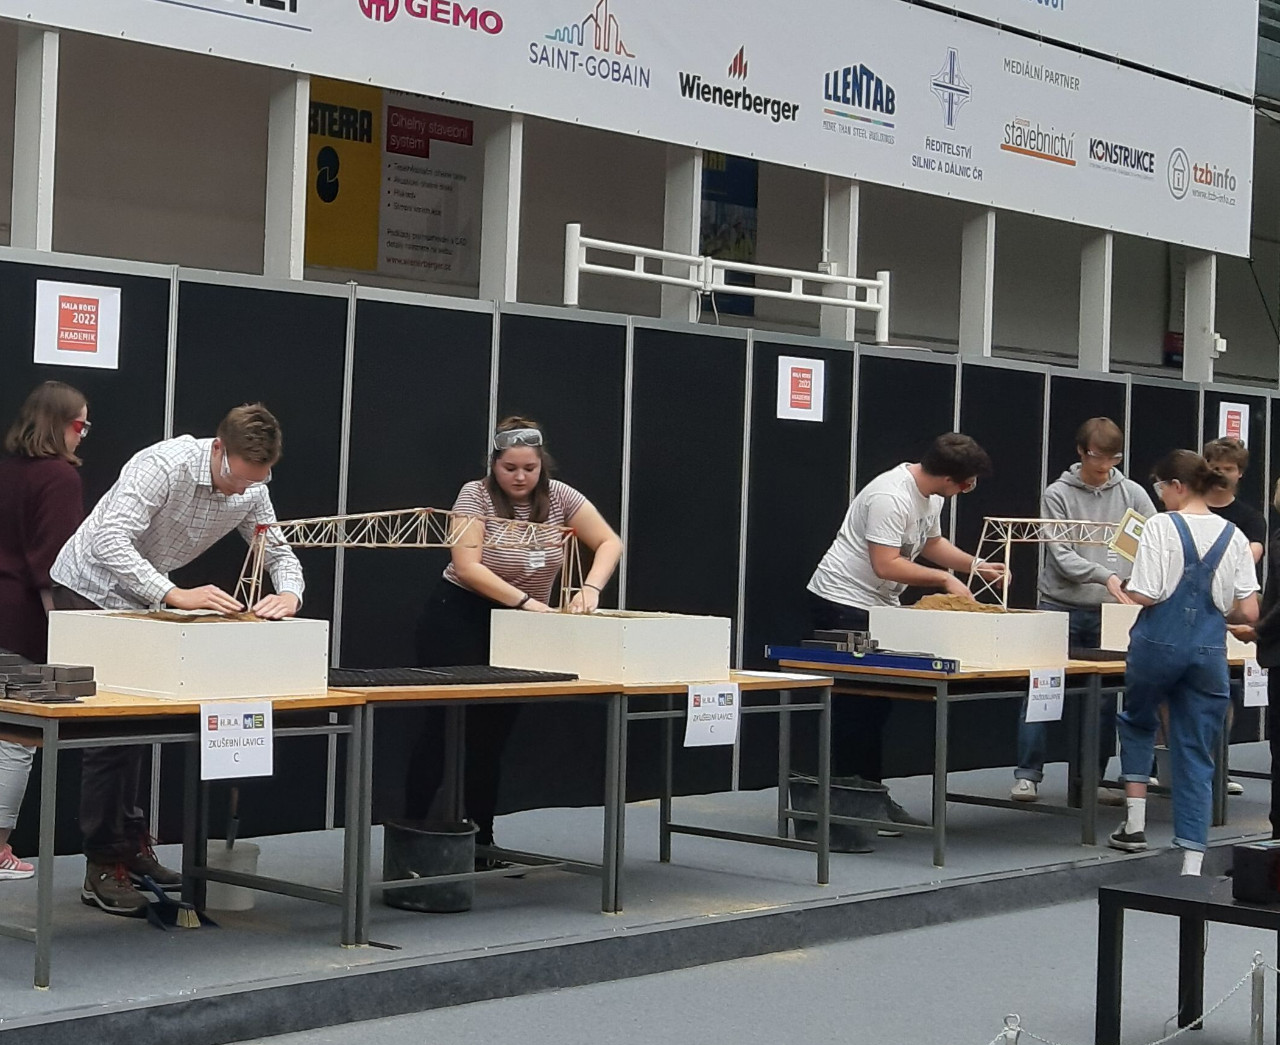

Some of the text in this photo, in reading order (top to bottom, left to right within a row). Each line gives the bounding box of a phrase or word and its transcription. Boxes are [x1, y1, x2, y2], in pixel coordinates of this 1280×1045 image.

[405, 0, 504, 35] GEMO
[529, 42, 650, 89] SAINT-GOBAIN
[1003, 57, 1080, 91] MEDIÁLNÍ PARTNER
[679, 71, 800, 123] Wienerberger
[824, 63, 896, 115] LLENTAB
[925, 136, 972, 160] ŘEDITELSTVÍ
[1004, 121, 1075, 159] stavebnictví
[1089, 137, 1155, 173] KONSTRUKCE
[912, 155, 983, 181] SILNIC A DÁLNIC ČR
[1193, 163, 1237, 191] tzbinfo
[61, 302, 78, 310] HALA
[72, 312, 96, 325] 2022
[208, 736, 265, 749] ZKUŠEBNÍ LAVICE
[233, 752, 240, 763] C
